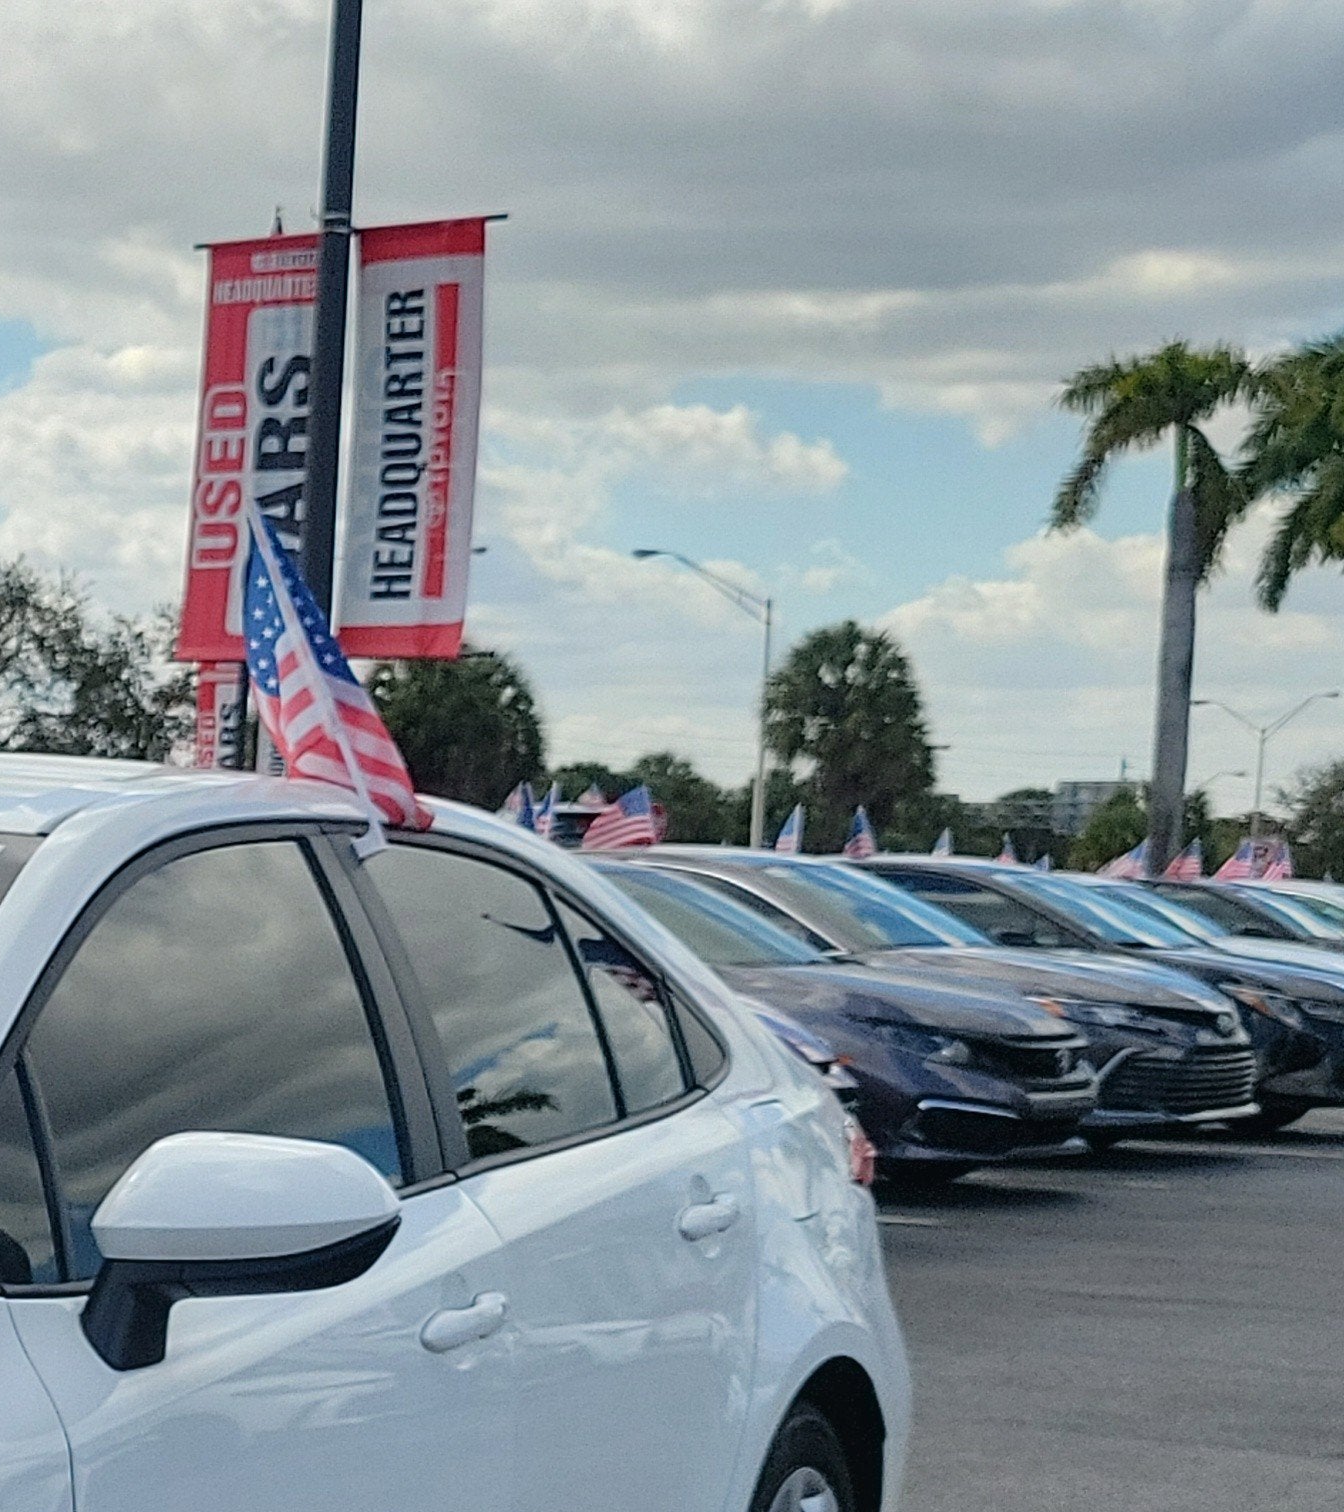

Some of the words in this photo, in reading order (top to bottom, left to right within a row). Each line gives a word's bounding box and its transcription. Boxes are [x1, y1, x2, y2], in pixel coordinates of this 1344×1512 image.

[195, 386, 248, 567] USED
[254, 354, 312, 551] ARS
[370, 289, 425, 601] HEADQUARTER
[199, 715, 215, 768] SED
